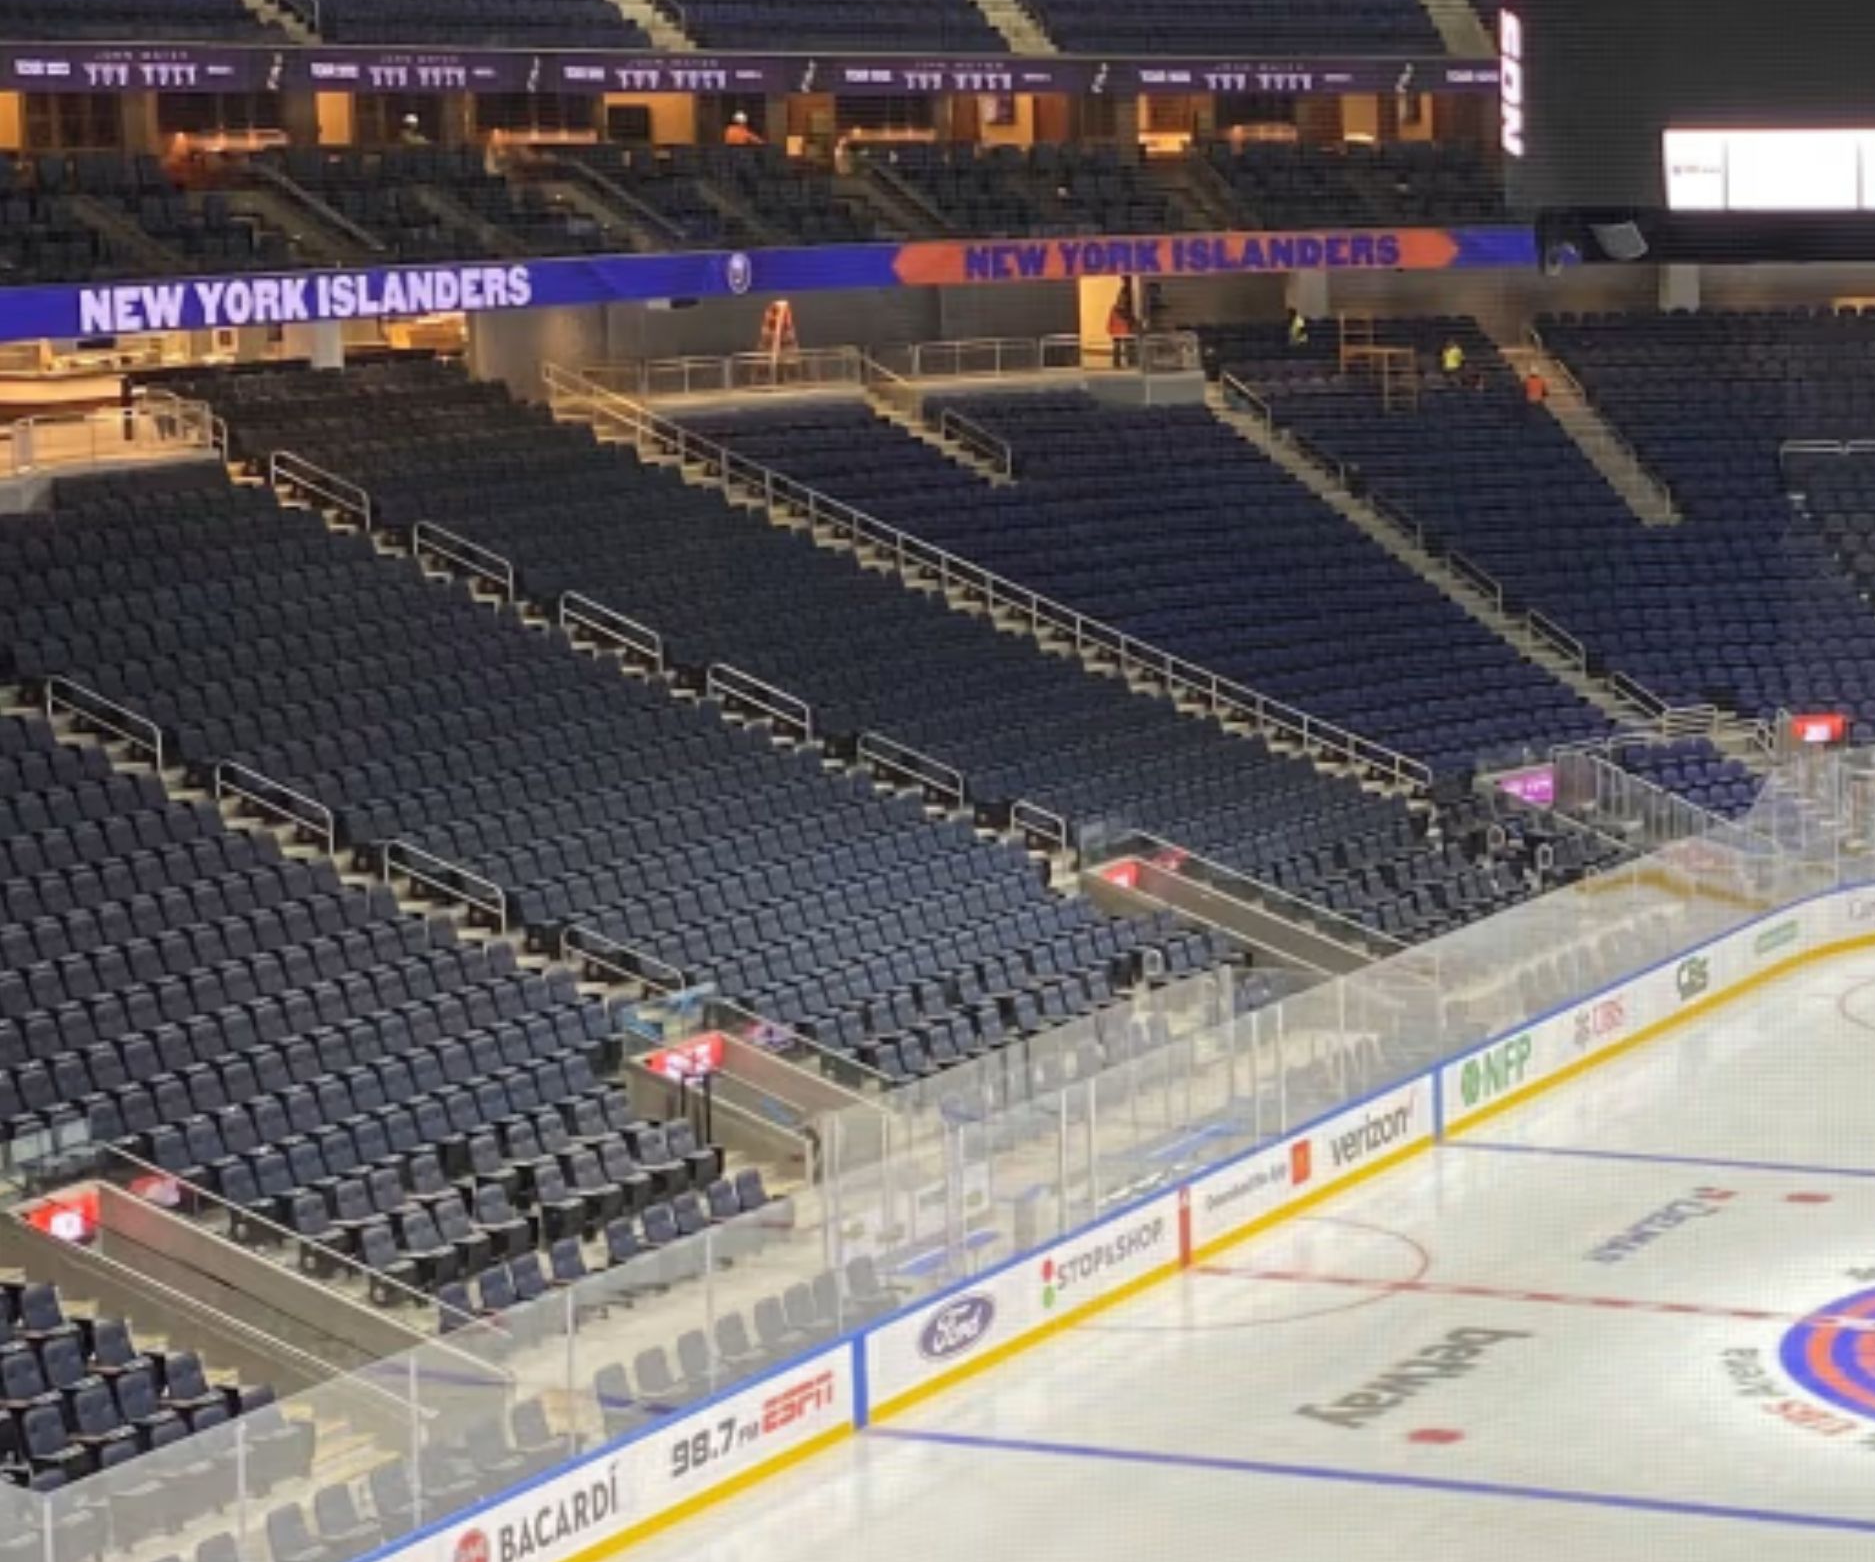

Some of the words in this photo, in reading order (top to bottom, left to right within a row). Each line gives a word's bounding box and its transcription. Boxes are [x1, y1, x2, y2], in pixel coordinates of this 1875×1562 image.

[1500, 8, 1525, 157] SON
[964, 244, 1047, 280] NEW
[1059, 241, 1162, 276] YORK
[1173, 236, 1400, 274] ISLANDERS
[80, 287, 187, 332] NEW
[197, 279, 308, 325] YORK
[317, 266, 532, 318] ISLANDERS
[1484, 1034, 1531, 1099] NFP
[1330, 1105, 1407, 1166] verizon
[761, 1370, 835, 1433] ESPN
